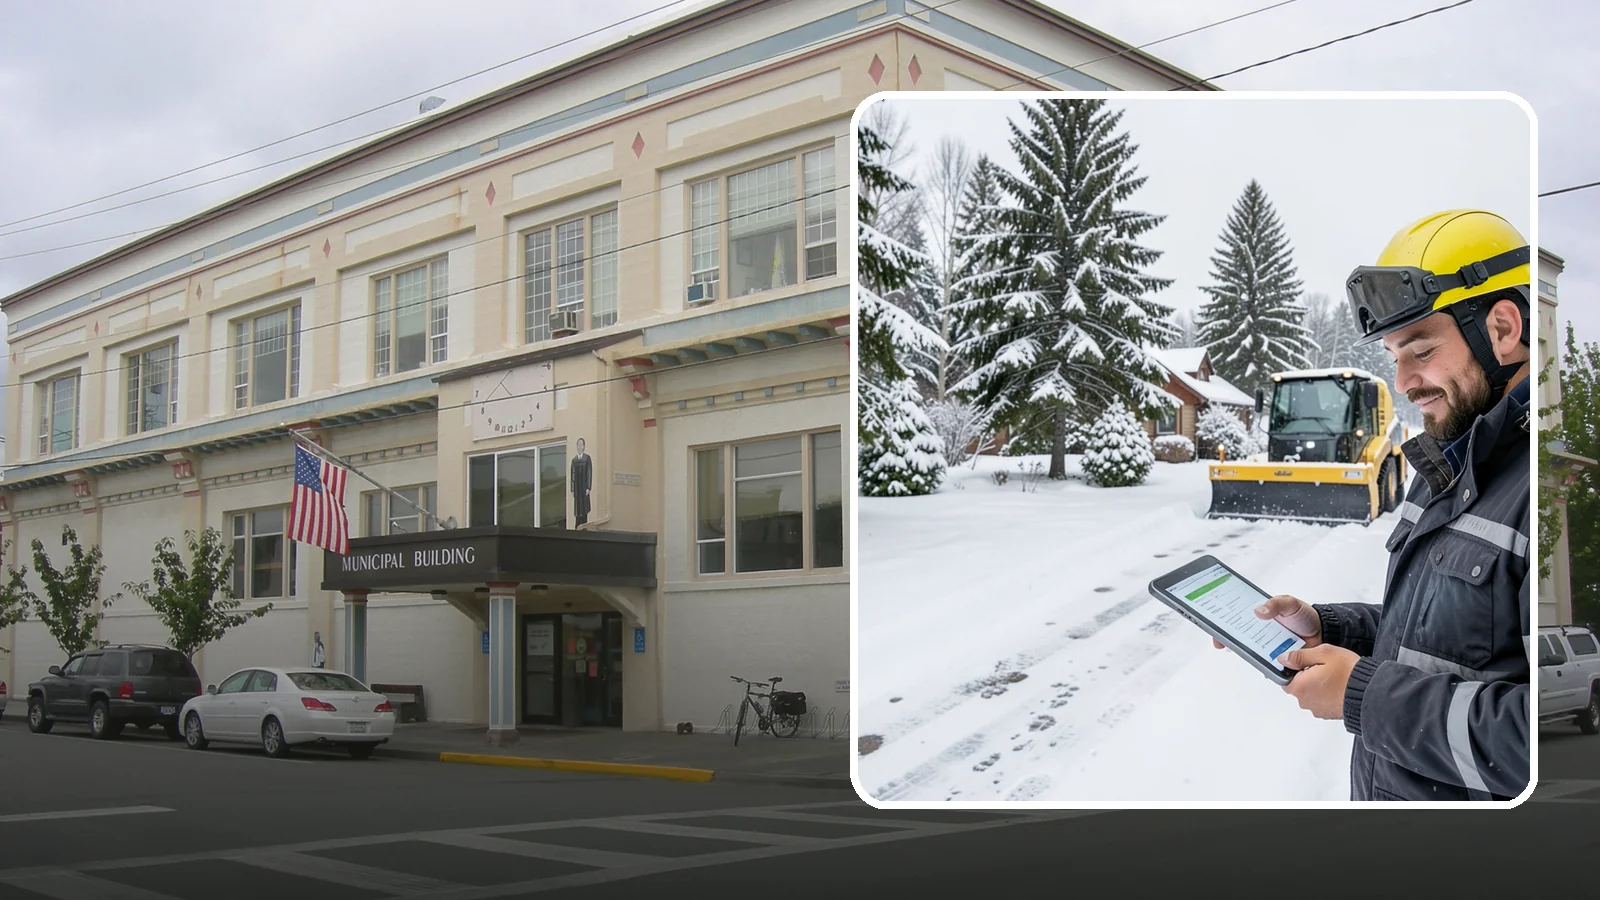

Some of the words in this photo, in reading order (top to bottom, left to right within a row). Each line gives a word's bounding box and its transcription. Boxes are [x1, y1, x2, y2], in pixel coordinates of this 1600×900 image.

[487, 417, 492, 425] 9
[494, 424, 500, 432] 10
[501, 425, 506, 433] 11
[507, 425, 513, 433] 12
[521, 420, 526, 428] 2
[528, 414, 533, 422] 3
[536, 402, 540, 410] 4
[342, 552, 405, 572] MUNICIPAL
[414, 546, 475, 567] BUILDING
